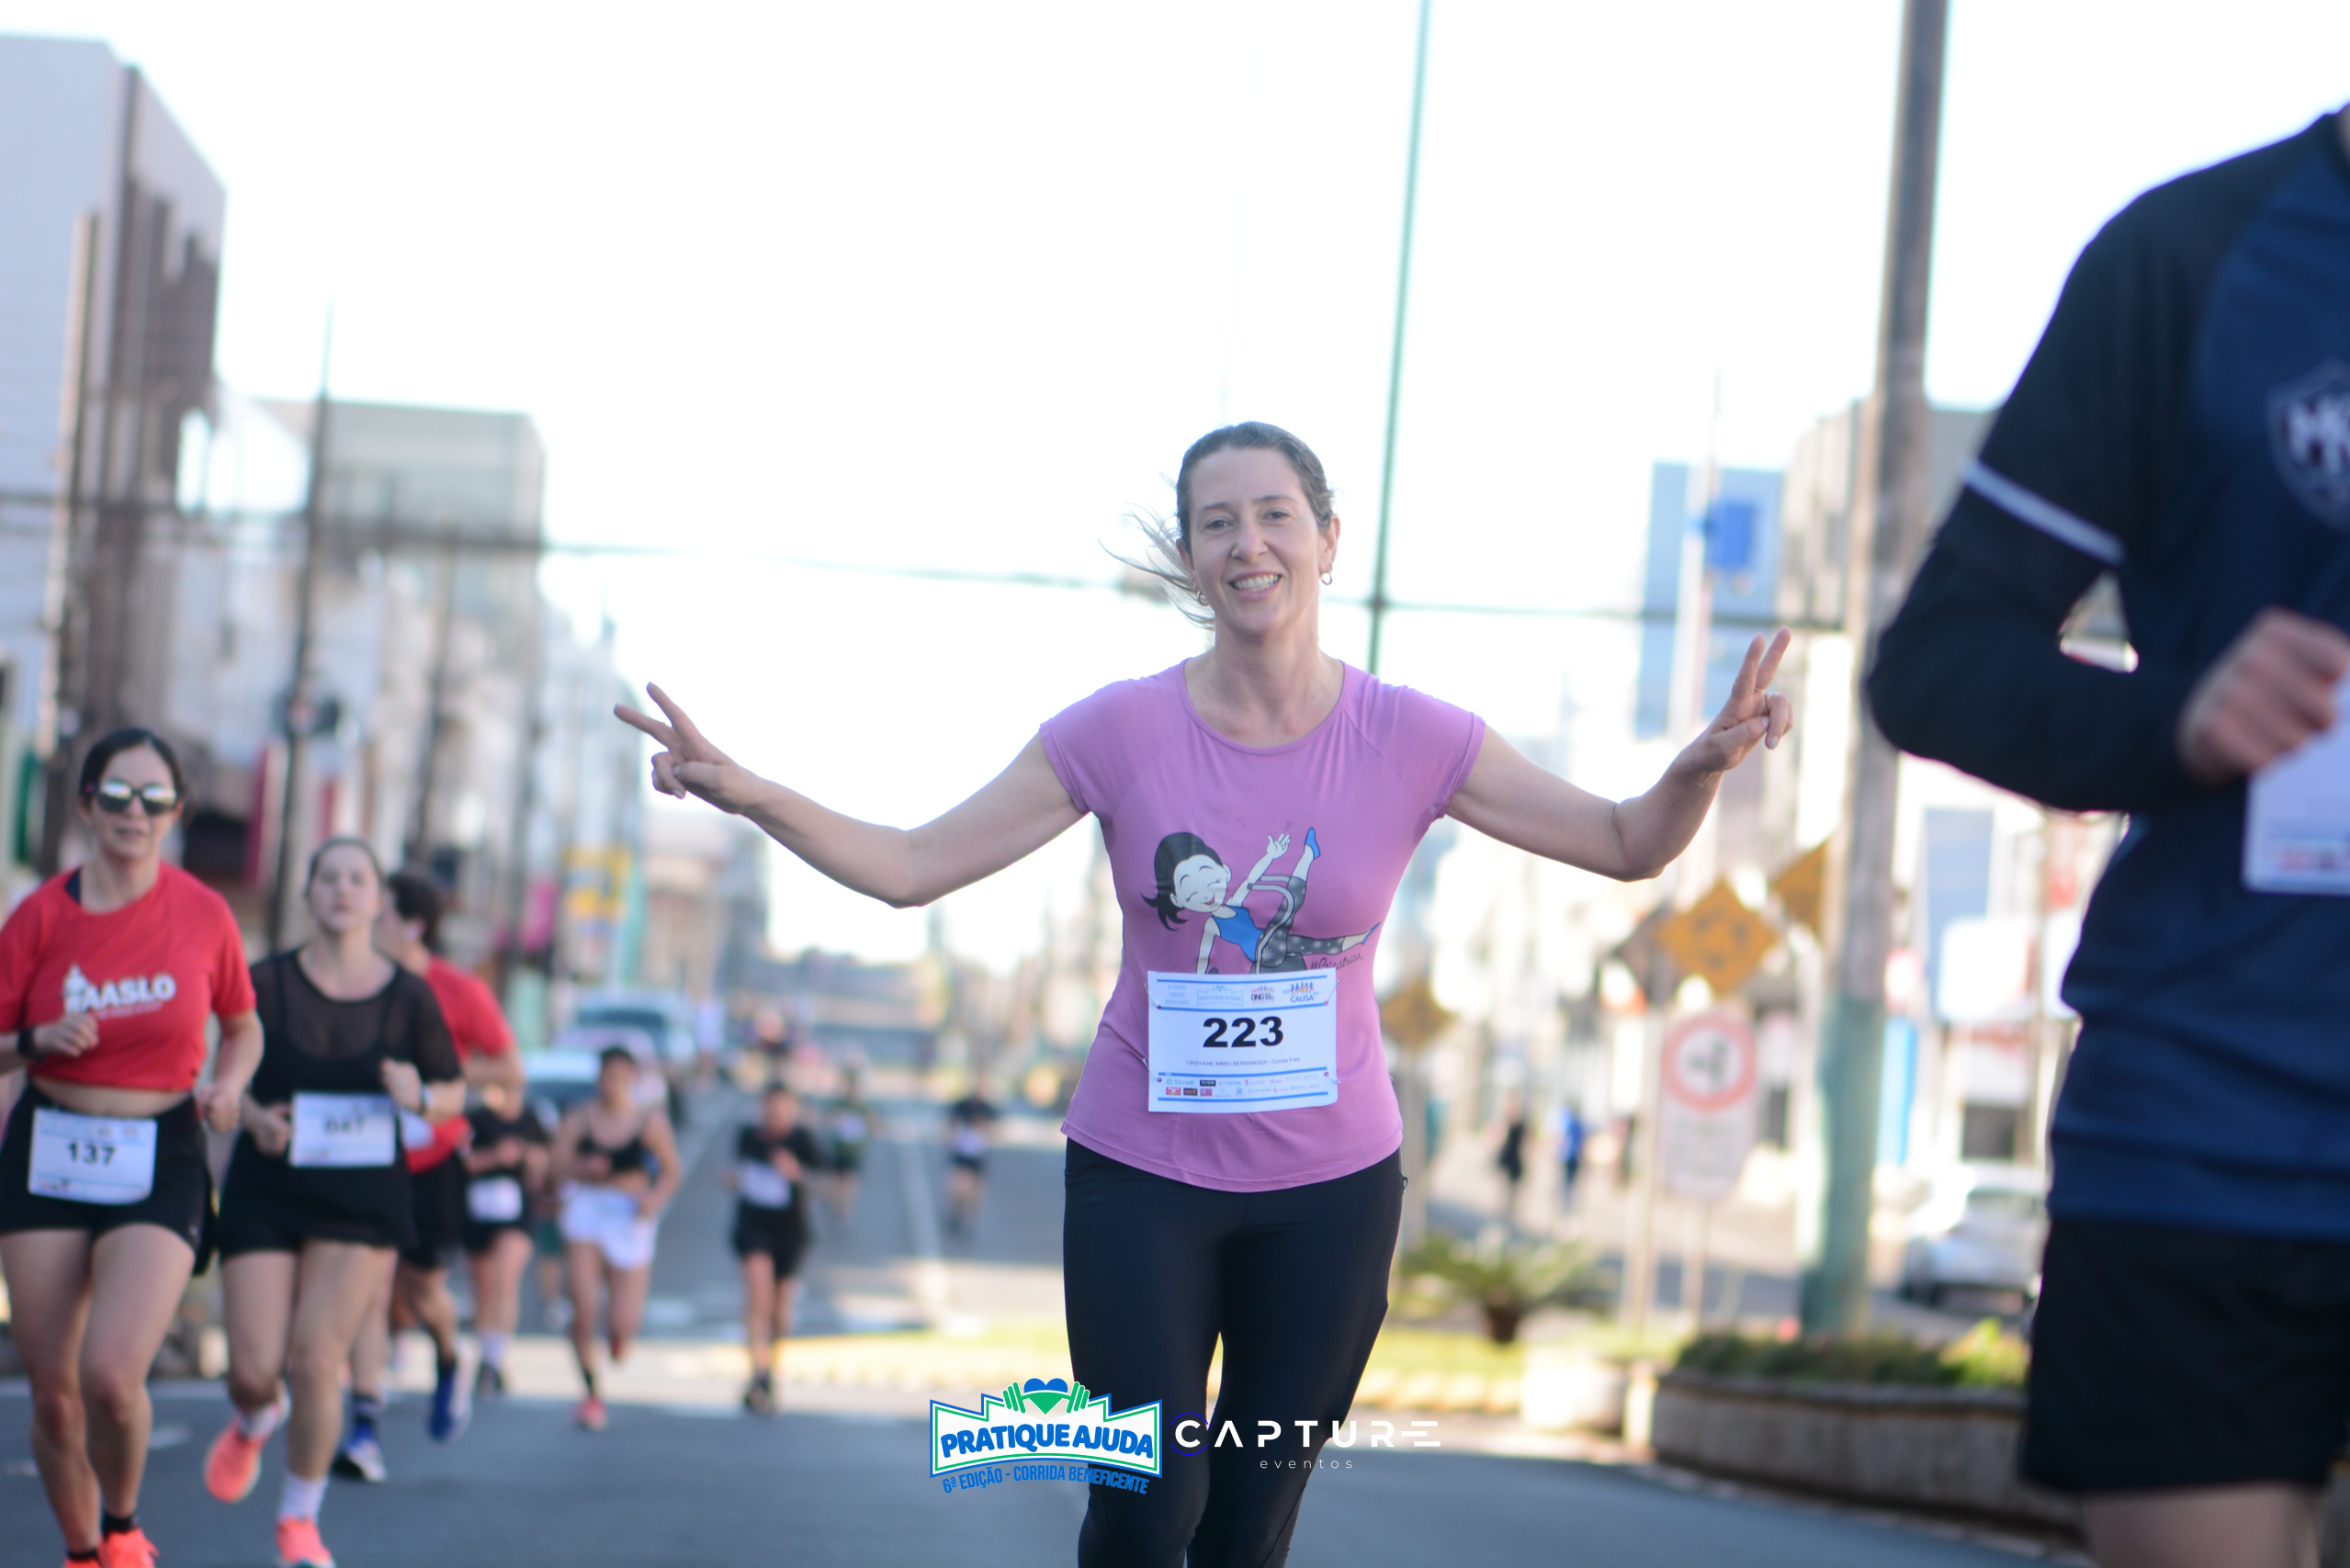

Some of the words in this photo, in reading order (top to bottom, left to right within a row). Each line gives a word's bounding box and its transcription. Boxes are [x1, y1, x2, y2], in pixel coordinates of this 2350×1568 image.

[1290, 994, 1315, 1003] CAUSA
[1203, 1016, 1284, 1048] 223
[68, 1142, 118, 1165] 137
